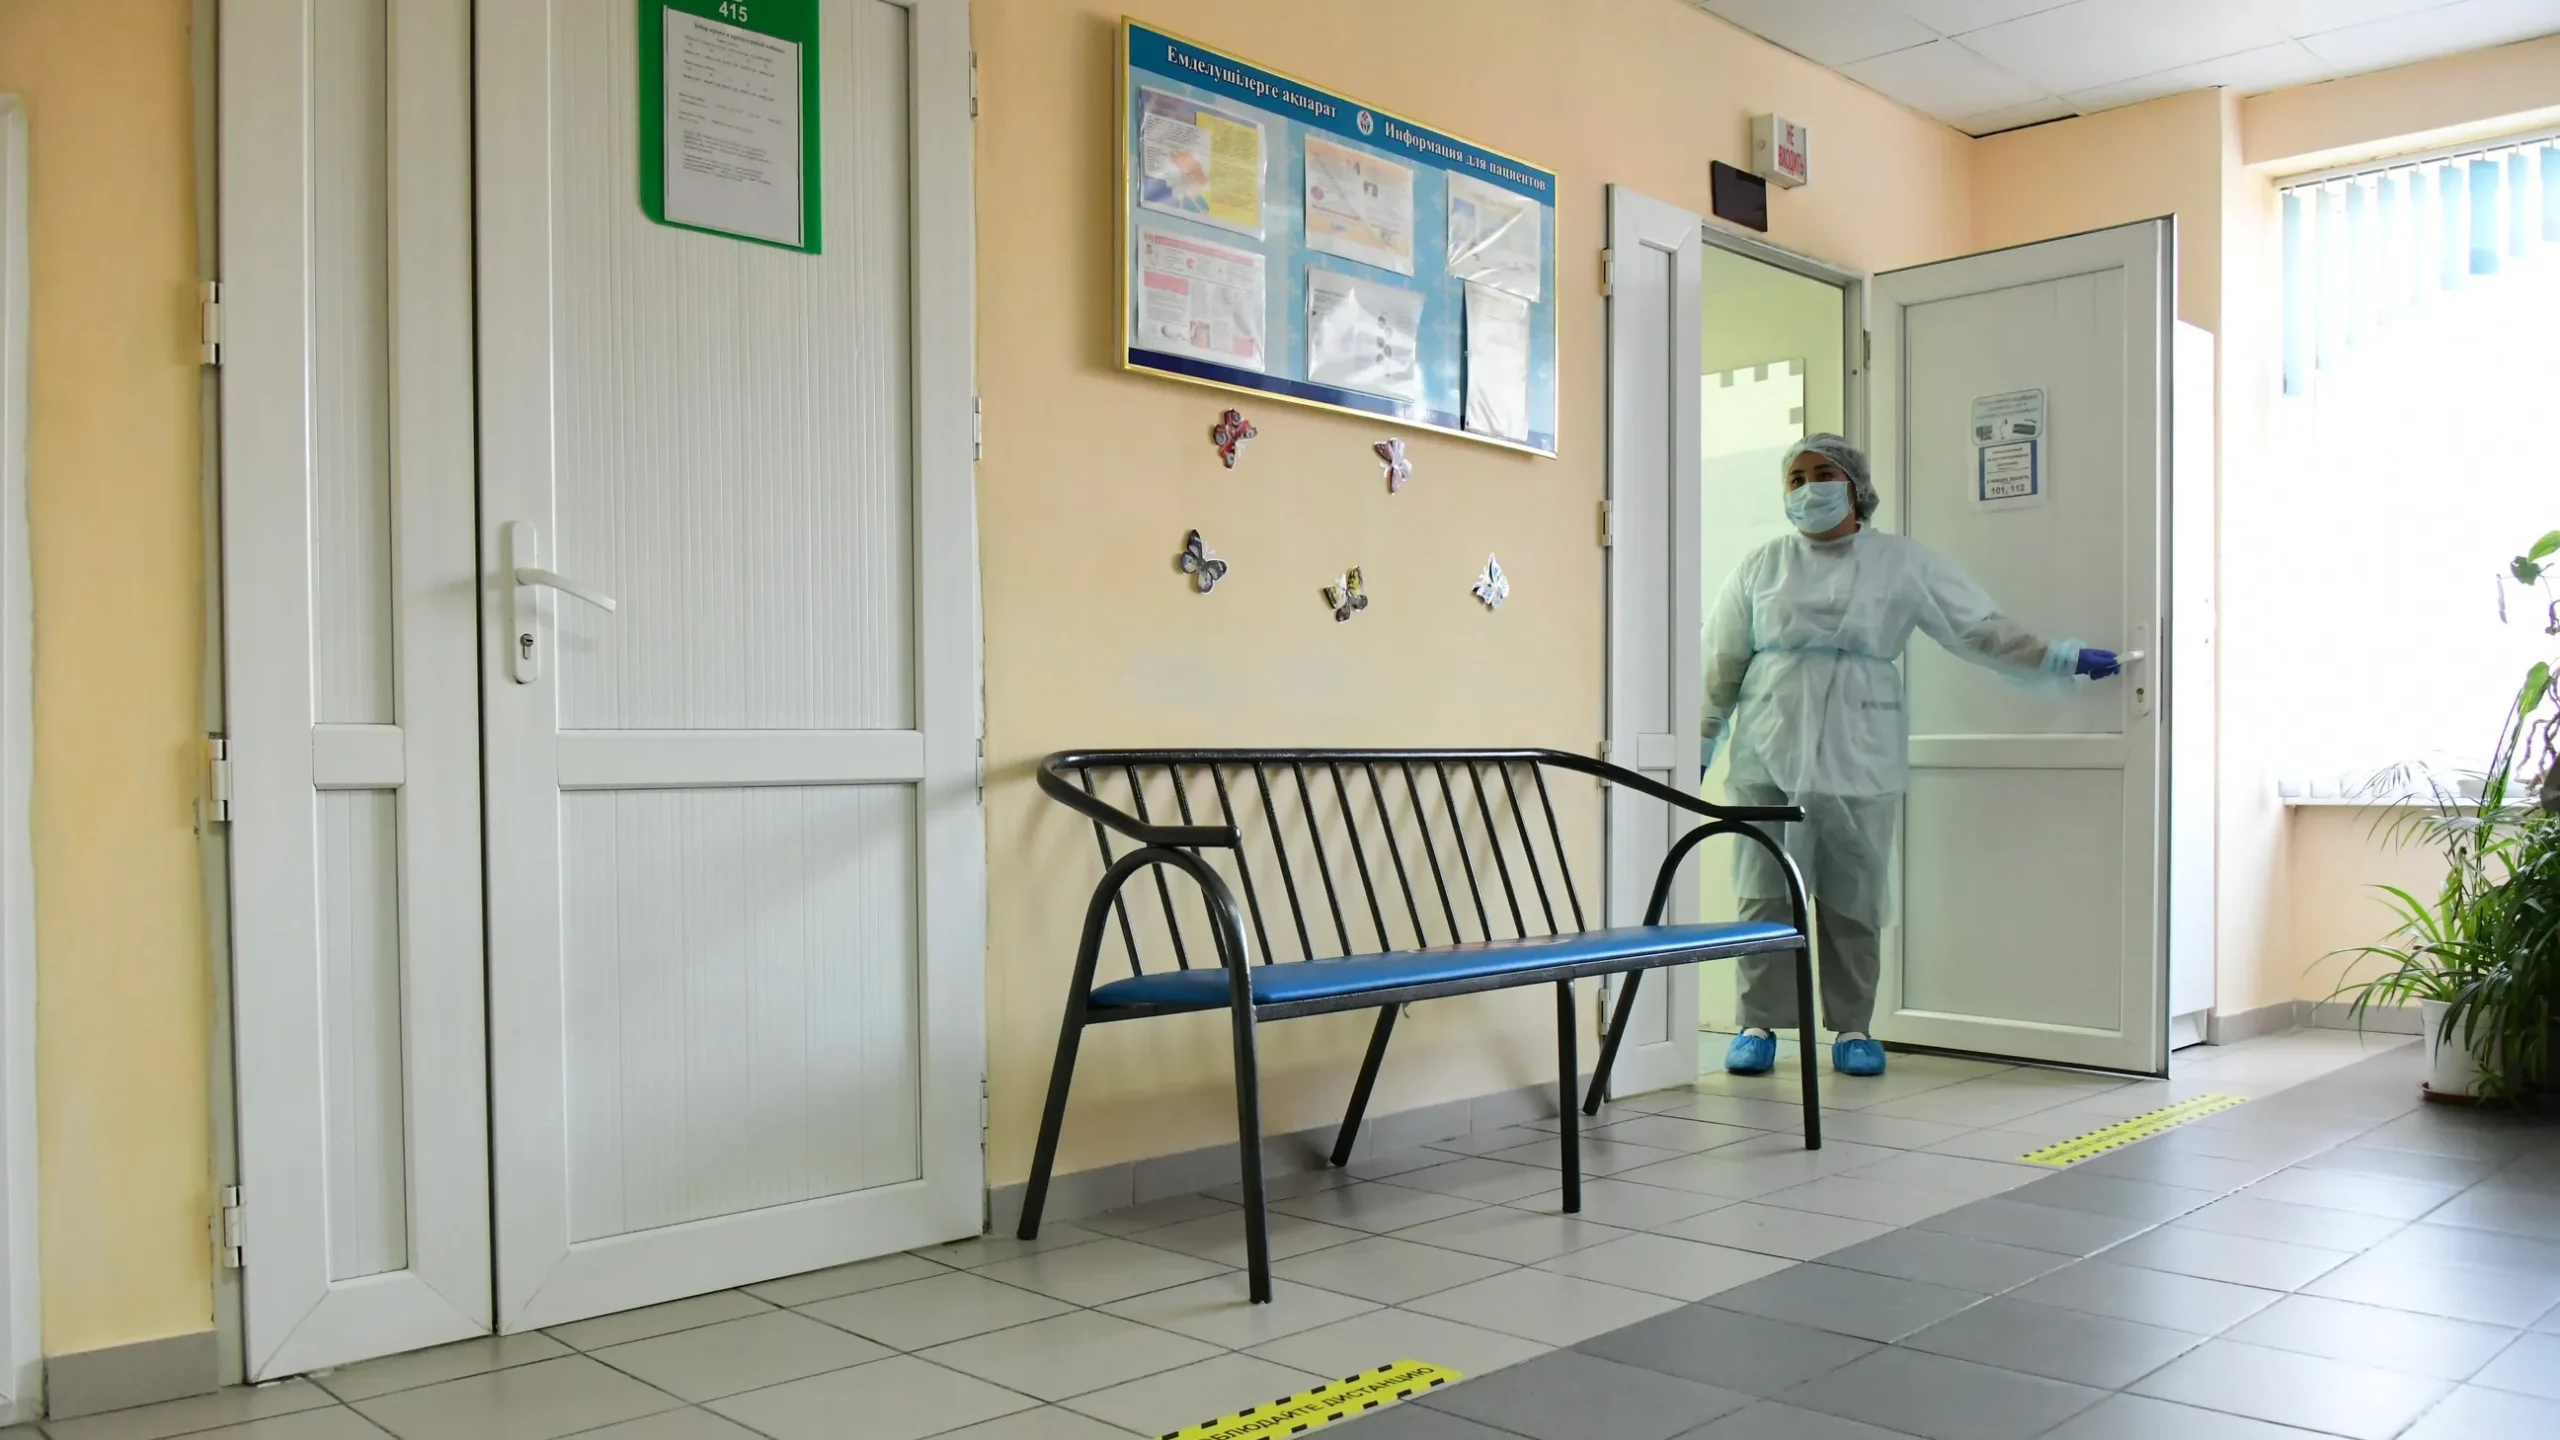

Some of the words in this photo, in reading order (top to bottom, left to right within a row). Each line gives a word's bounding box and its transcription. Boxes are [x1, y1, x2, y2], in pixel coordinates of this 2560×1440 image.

[719, 1, 748, 22] 415
[1167, 44, 1279, 98] Емделушілерге
[1282, 88, 1338, 119] ақпарат
[1385, 121, 1463, 162] Информация
[1466, 155, 1486, 171] для
[1489, 162, 1546, 191] пациентов
[1199, 1403, 1324, 1440] БЛЮДАЙТЕ
[1321, 1367, 1434, 1407] ДИСТАНЦИЮ
